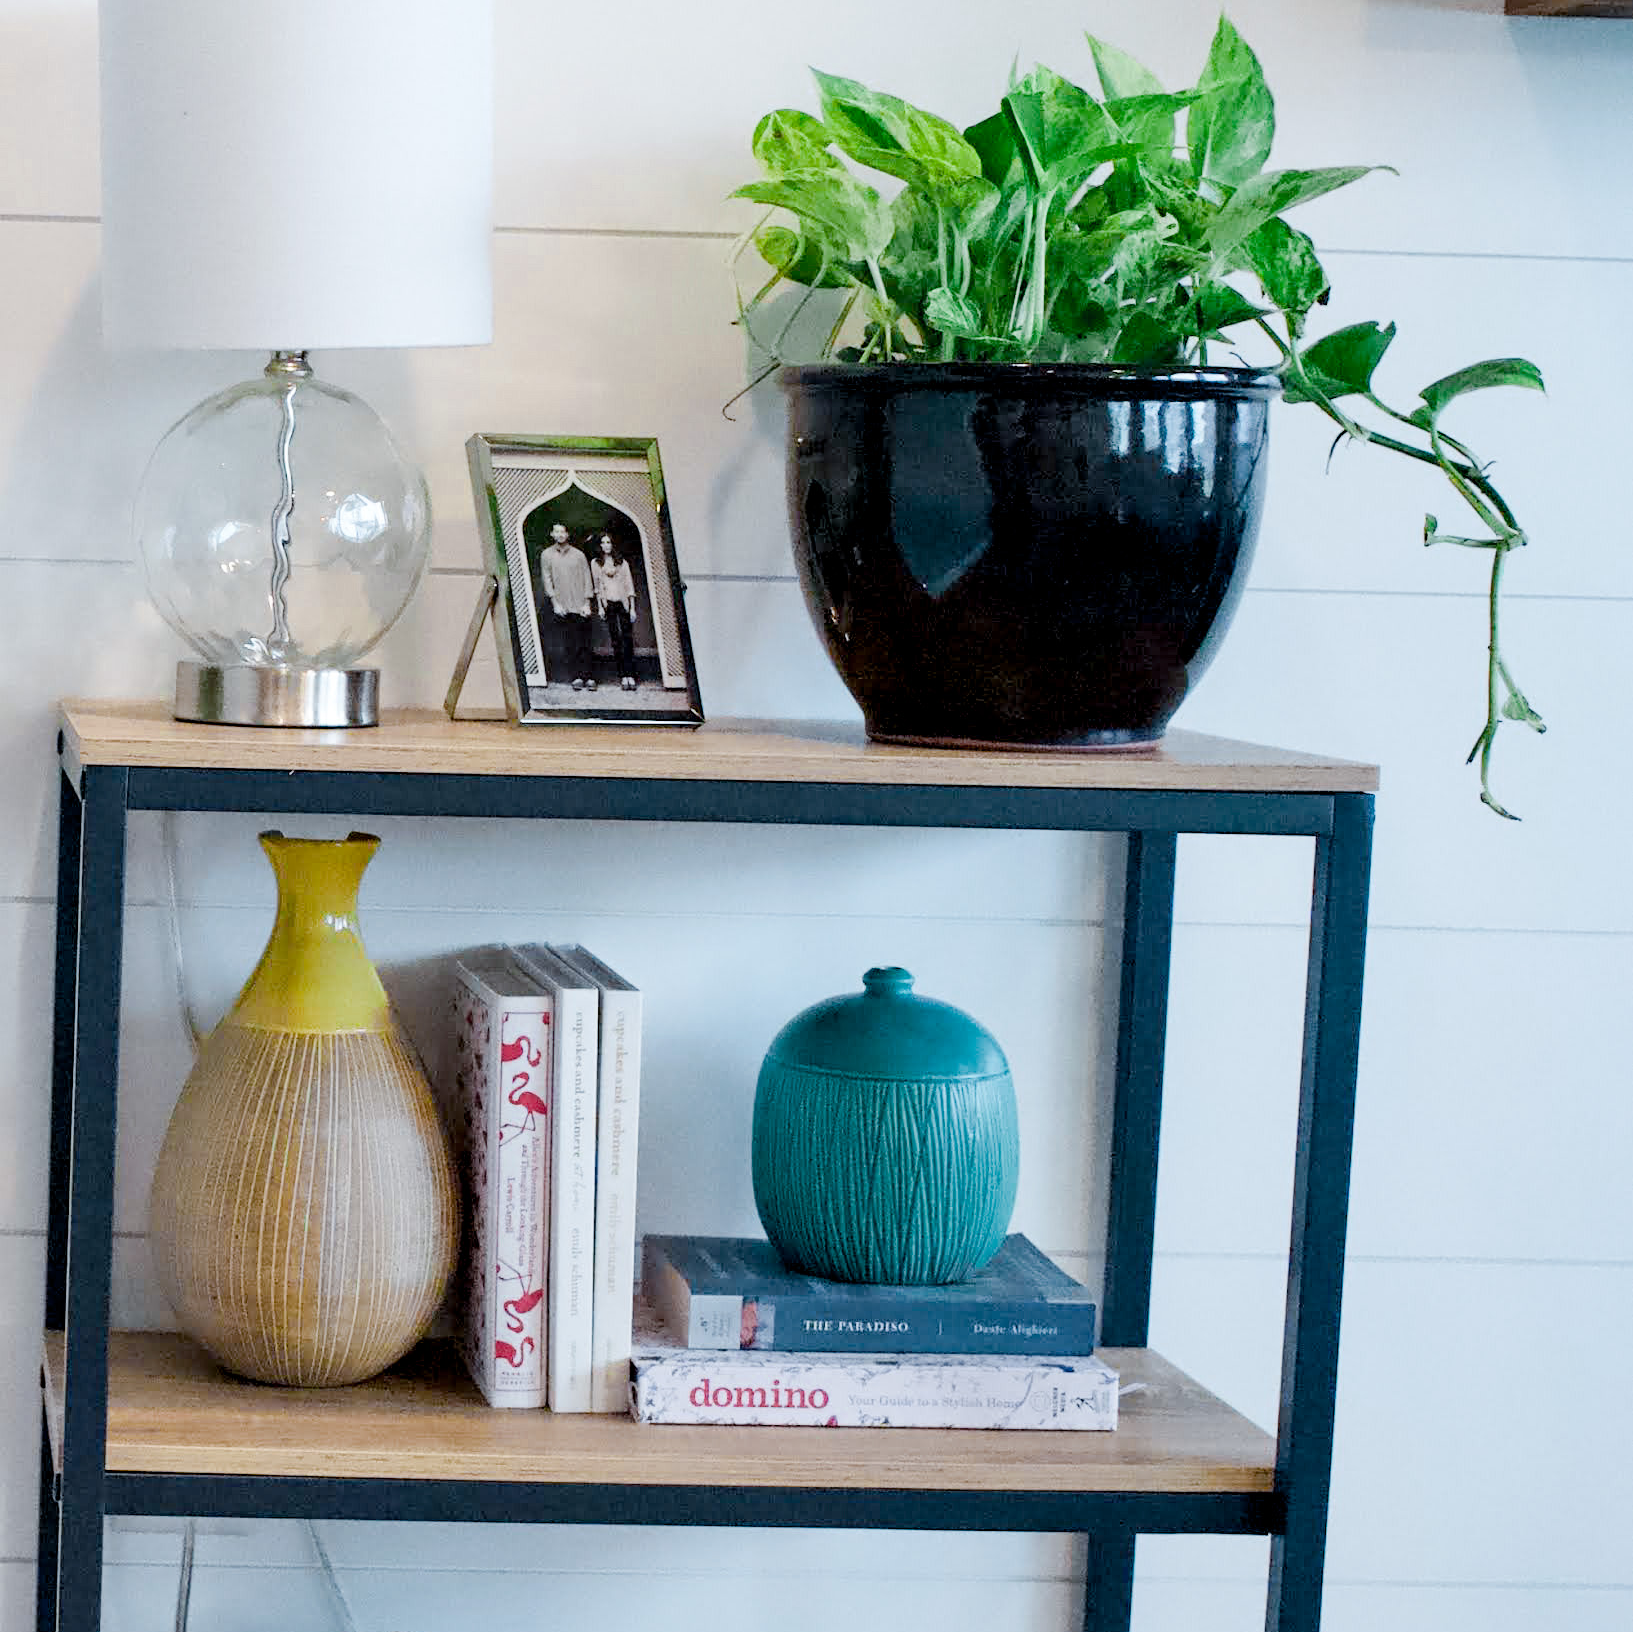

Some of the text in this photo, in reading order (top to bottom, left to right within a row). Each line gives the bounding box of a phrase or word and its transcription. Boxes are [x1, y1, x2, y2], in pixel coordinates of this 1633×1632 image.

[572, 1011, 587, 1067] cupcakes
[612, 1010, 628, 1073] cupcakes
[573, 1070, 585, 1095] and
[613, 1077, 627, 1104] and
[572, 1098, 585, 1158] cashmere
[610, 1108, 625, 1176] cashmere
[803, 1319, 909, 1332] THE PARADISO
[689, 1378, 829, 1409] domino
[848, 1394, 876, 1407] Your
[879, 1395, 914, 1407] Guide
[917, 1397, 929, 1408] to
